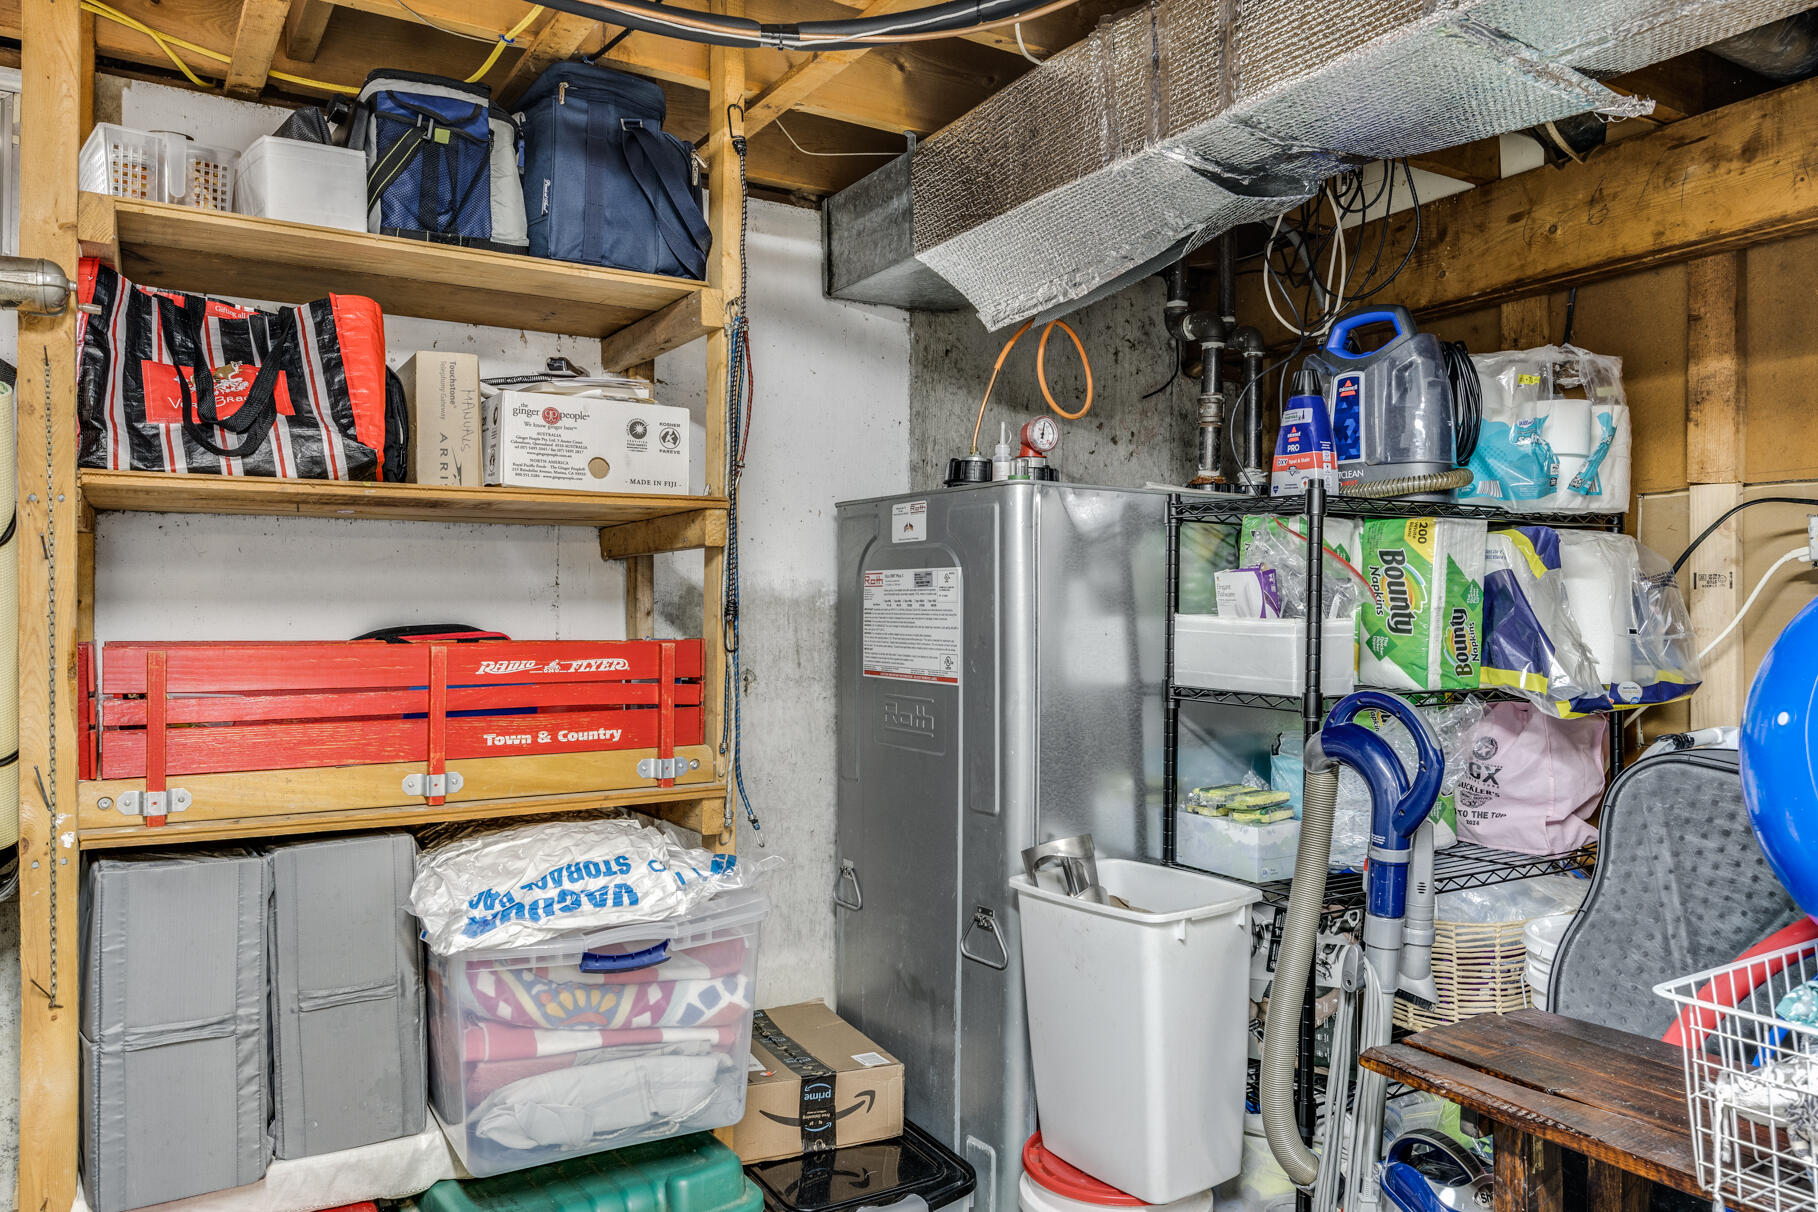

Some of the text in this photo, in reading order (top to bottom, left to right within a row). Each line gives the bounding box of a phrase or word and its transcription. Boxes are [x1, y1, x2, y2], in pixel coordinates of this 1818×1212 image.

[449, 361, 457, 405] Touchstone
[439, 393, 447, 420] Gateway
[512, 406, 585, 422] ginger people
[460, 388, 476, 453] MANUALS
[1287, 444, 1300, 453] PRO
[1418, 521, 1428, 544] 200
[864, 576, 884, 585] Roth
[1369, 566, 1384, 616] Napkins
[1379, 549, 1416, 635] Bounty
[1450, 608, 1473, 676] Bounty
[1468, 622, 1480, 662] Napkins
[475, 658, 629, 674] RADIO FLYER
[885, 701, 934, 730] Roth
[1370, 712, 1379, 732] apkin
[484, 728, 622, 746] Town & Country
[1471, 810, 1489, 820] THE
[804, 1089, 832, 1102] prime
